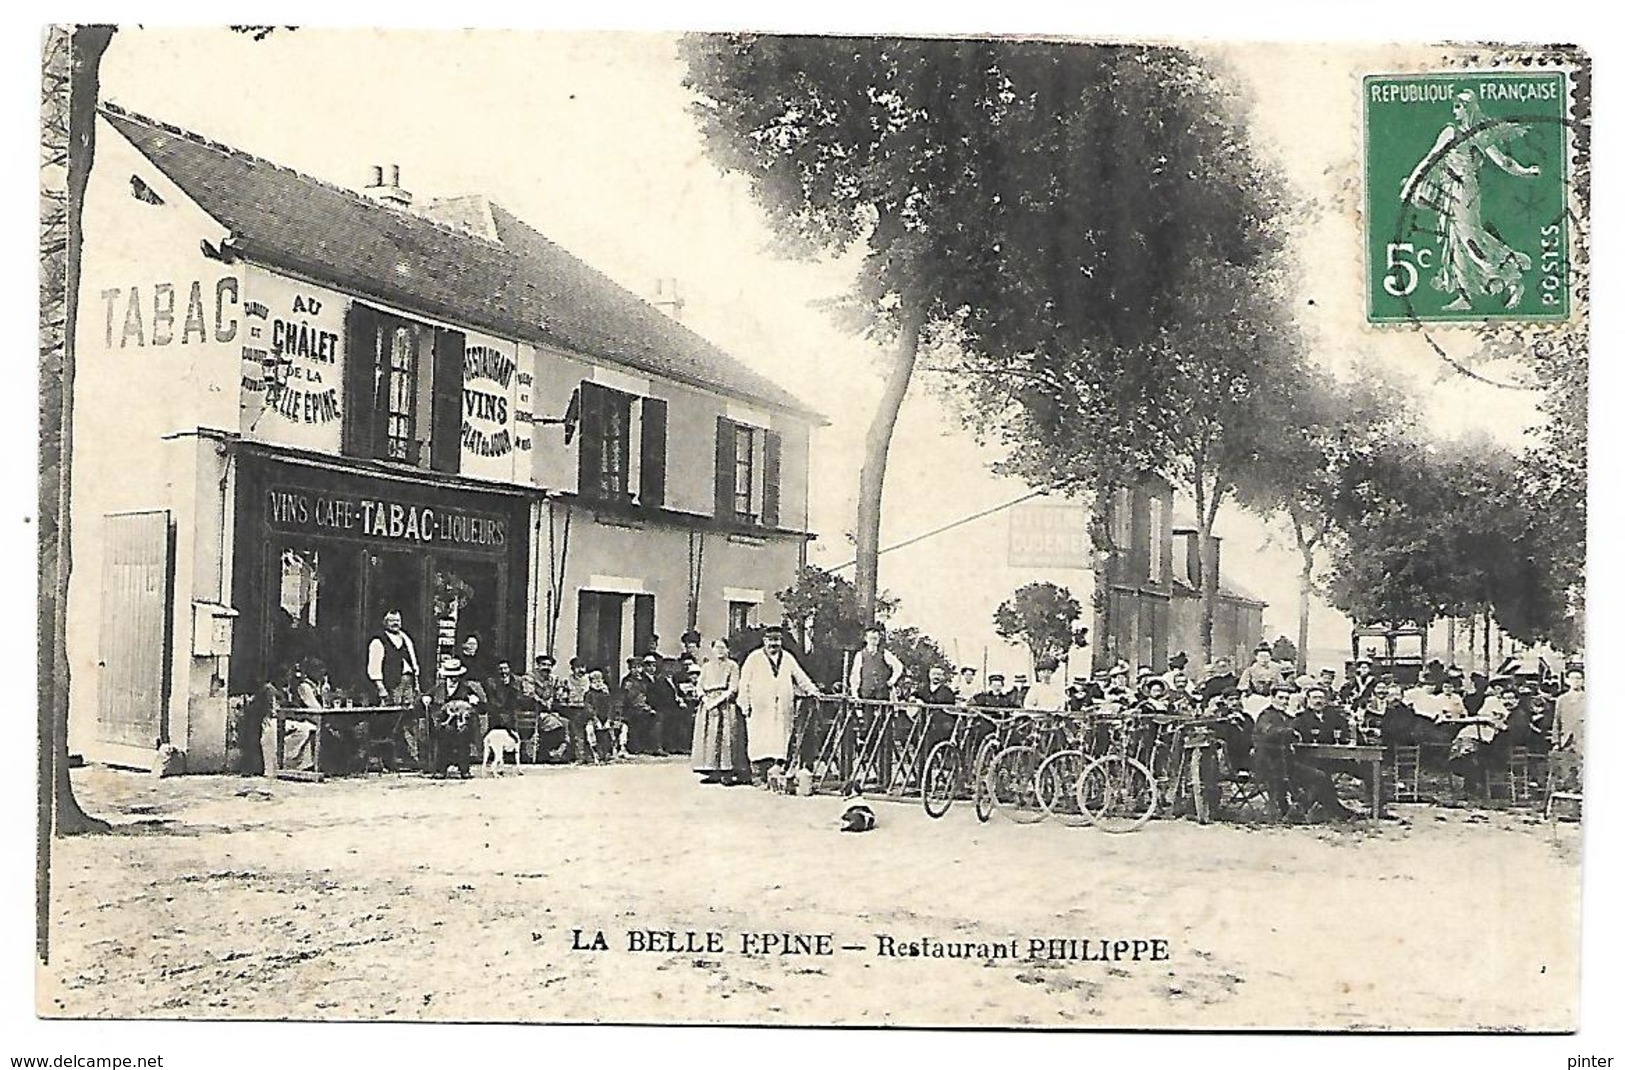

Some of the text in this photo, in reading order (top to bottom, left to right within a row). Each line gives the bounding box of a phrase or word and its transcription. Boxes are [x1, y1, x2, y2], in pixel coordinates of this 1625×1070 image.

[1480, 82, 1557, 102] FRANÇAISE
[1540, 224, 1560, 306] POSTES
[101, 277, 238, 349] TABAC
[292, 295, 322, 315] AU
[273, 320, 339, 364] CHÂLET
[286, 366, 322, 383] DE LA
[304, 389, 342, 423] ÉPINE
[462, 388, 508, 425] VINS
[271, 492, 309, 524] VINS
[361, 500, 434, 541] TABAC
[440, 513, 505, 546] LIQUEURS
